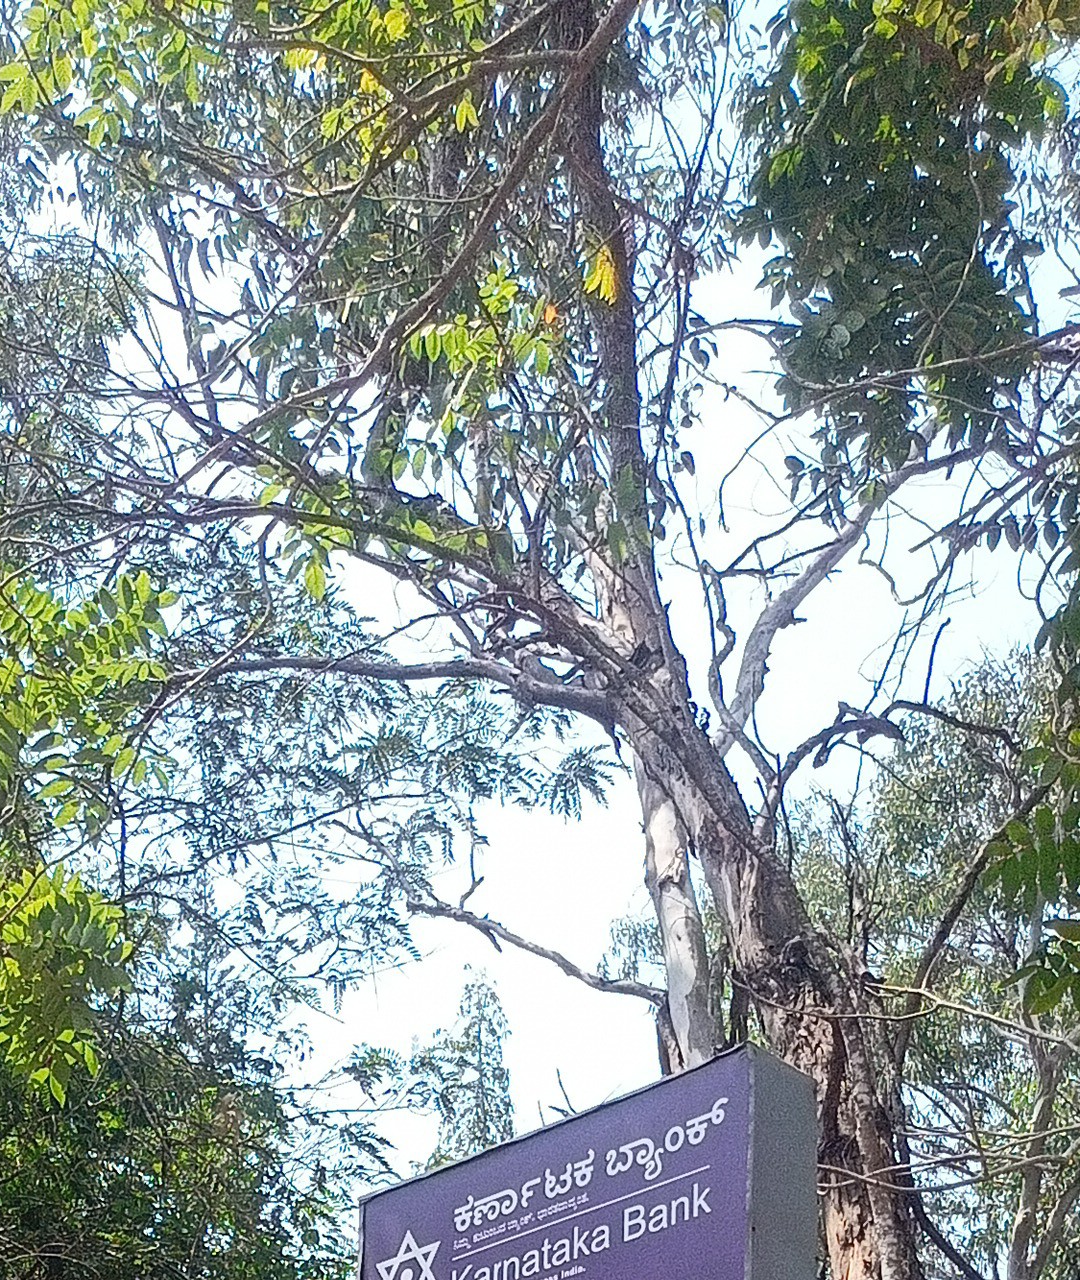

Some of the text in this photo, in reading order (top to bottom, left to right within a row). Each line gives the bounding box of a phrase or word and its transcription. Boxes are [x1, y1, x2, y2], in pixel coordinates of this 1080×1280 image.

[605, 1097, 729, 1181] ಬ್ಯಾಂಕ್
[622, 1182, 712, 1244] Bank
[561, 1264, 587, 1279] India.
